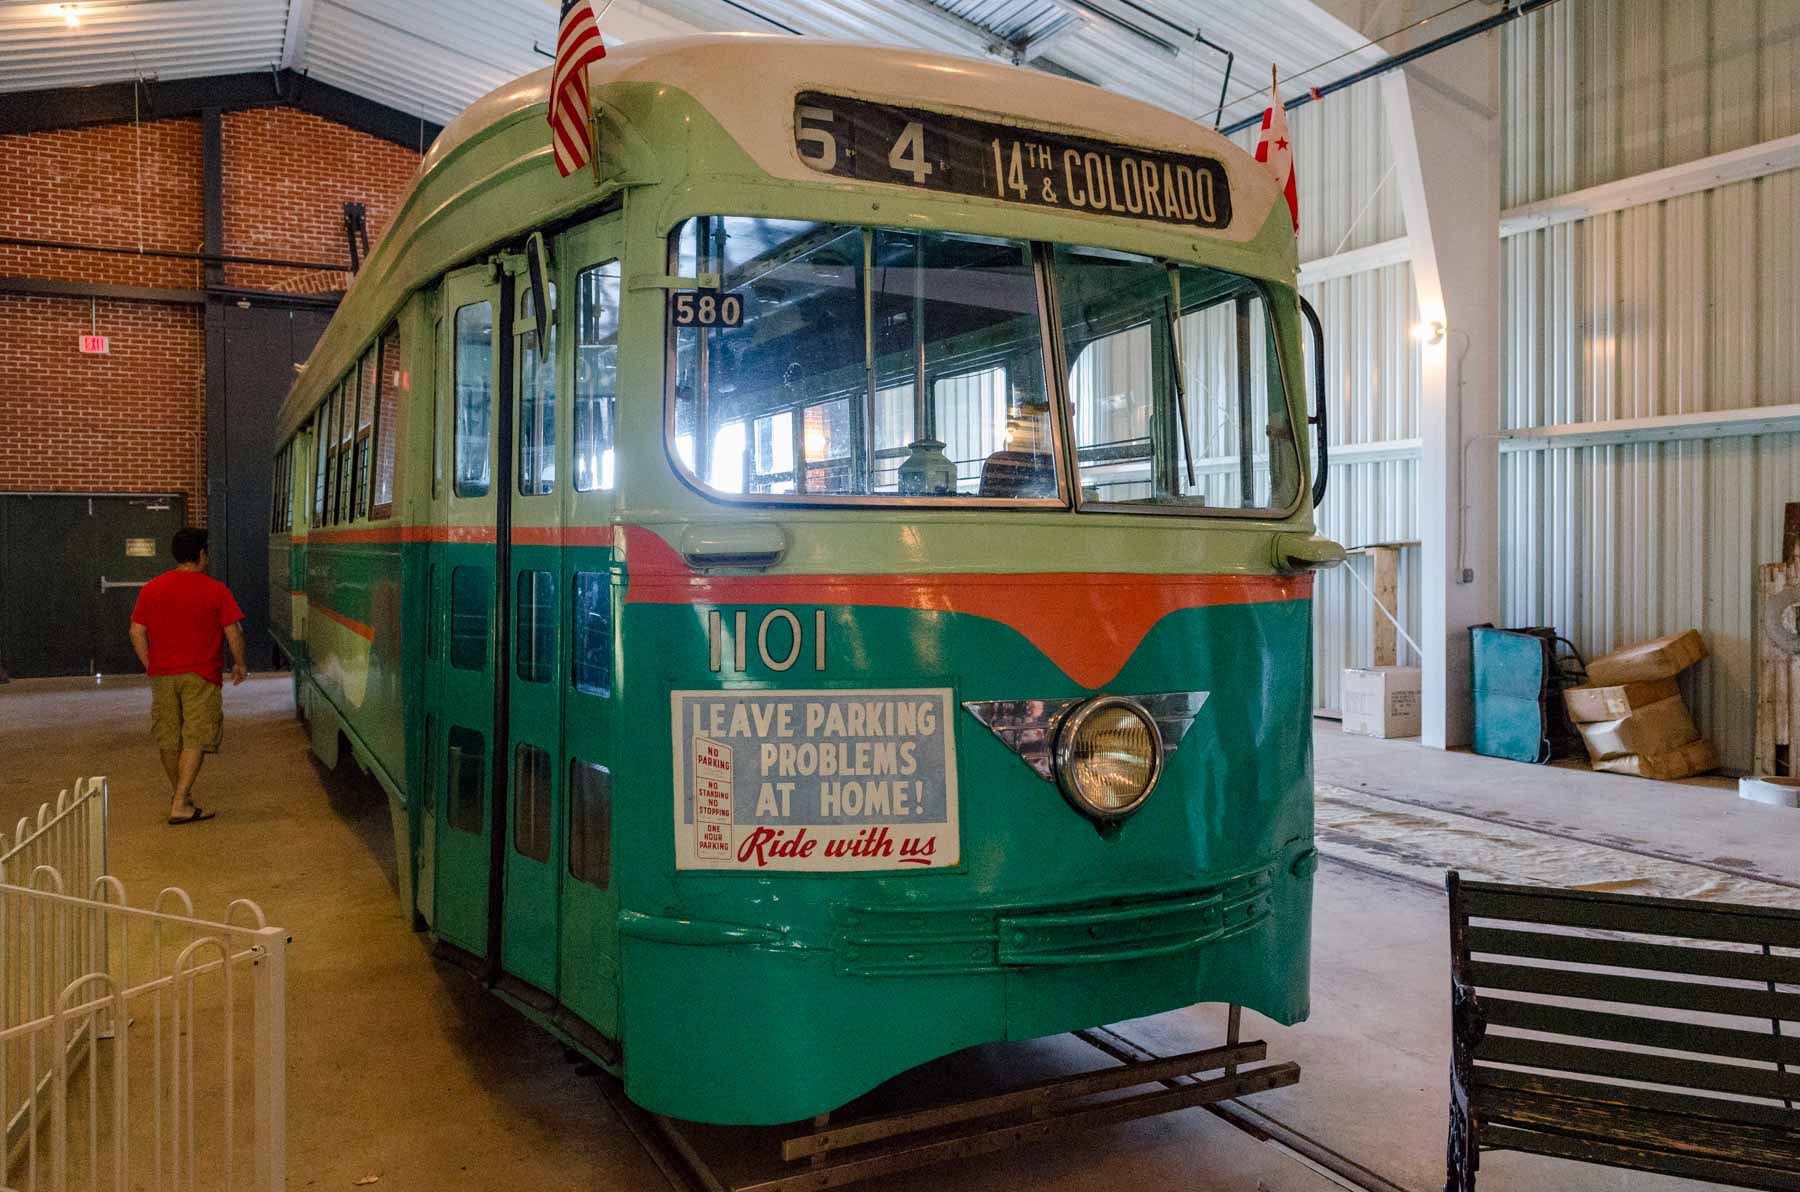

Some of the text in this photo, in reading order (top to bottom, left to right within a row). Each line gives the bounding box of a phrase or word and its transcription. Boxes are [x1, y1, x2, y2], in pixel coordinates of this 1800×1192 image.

[888, 122, 933, 184] 4
[991, 138, 1053, 200] 14TH
[1041, 177, 1058, 203] &
[1063, 148, 1217, 223] COLORADO
[676, 295, 741, 326] 580
[84, 337, 105, 351] EXIT
[708, 608, 826, 672] 1101
[692, 702, 936, 737] LEAVE PARKING
[708, 746, 718, 757] NO
[698, 755, 730, 770] PARKING
[760, 742, 917, 777] PROBLEMS
[698, 789, 729, 799] STANDING
[755, 781, 925, 817] AT HOME!
[708, 798, 719, 806] NO
[699, 807, 730, 817] STOPPING
[707, 825, 721, 833] ONE
[704, 833, 723, 841] HOUR
[699, 841, 729, 850] PARKING
[737, 827, 937, 866] Ride with us
